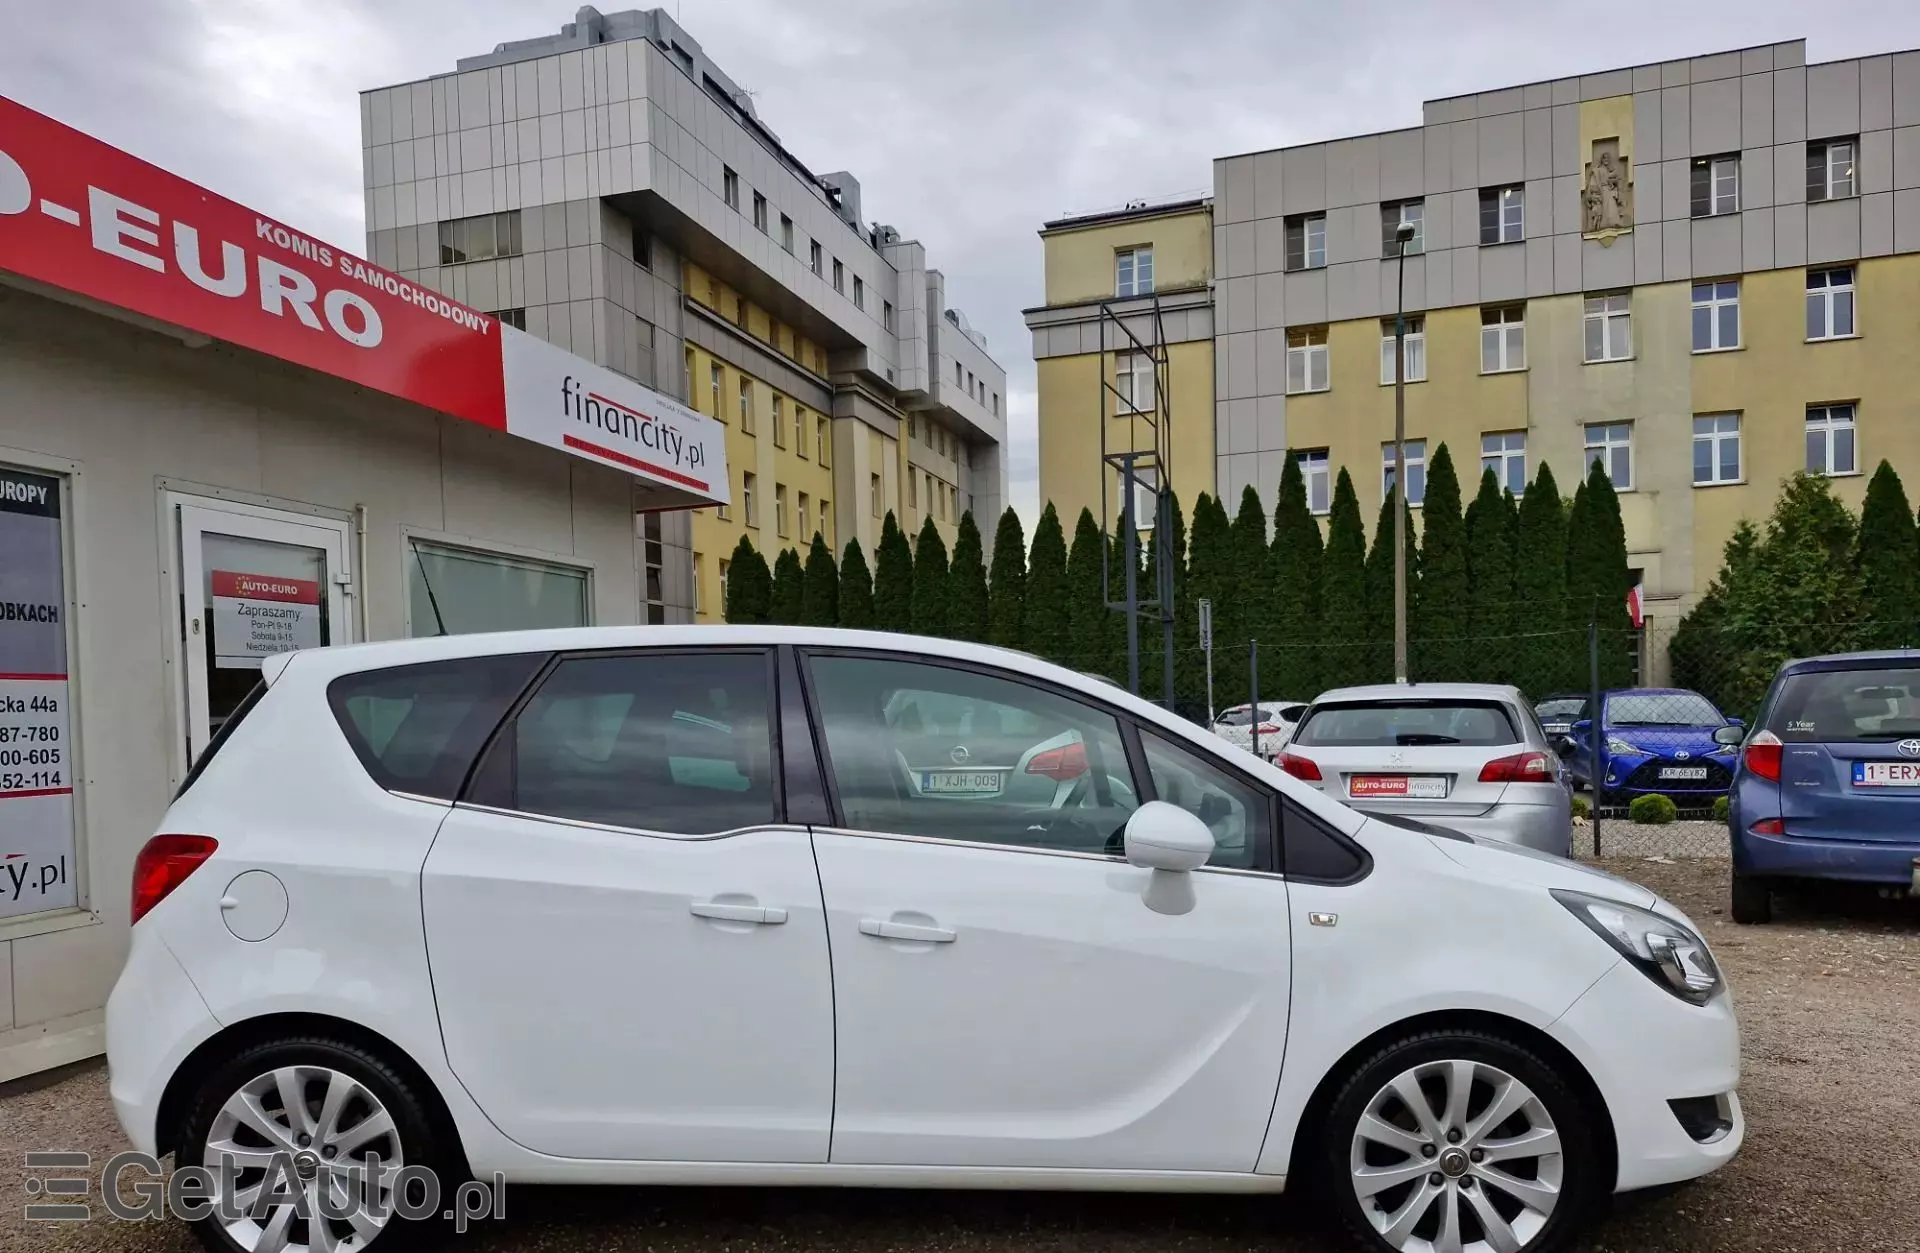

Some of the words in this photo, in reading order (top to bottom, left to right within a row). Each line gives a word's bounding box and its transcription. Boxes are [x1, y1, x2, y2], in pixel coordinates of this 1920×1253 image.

[256, 218, 333, 267] KOMIS
[340, 256, 490, 335] SAMOCHODOWY
[561, 375, 705, 469] financity.pl
[241, 581, 298, 595] AUTO-EURO
[237, 602, 303, 622] Zapraszamy:
[251, 631, 276, 641] Sobota
[246, 642, 278, 652] Niedziela
[30, 696, 58, 713] 44a
[1795, 720, 1815, 728] Year
[0, 771, 61, 790] 52-114
[0, 855, 66, 901] y.pl
